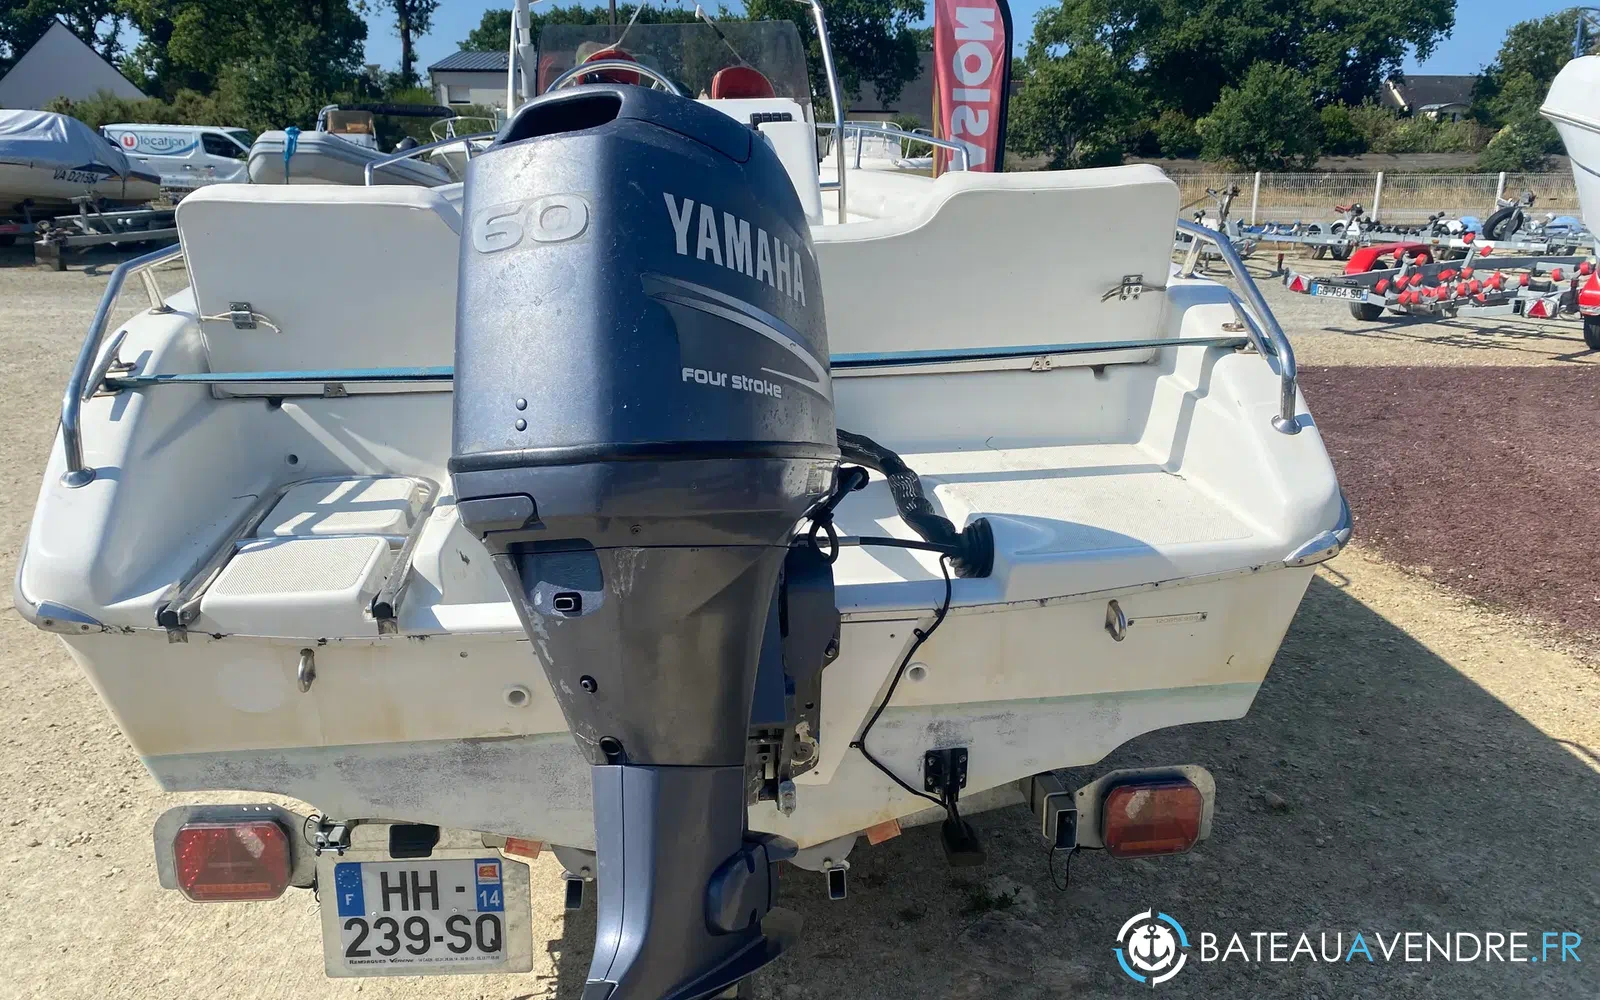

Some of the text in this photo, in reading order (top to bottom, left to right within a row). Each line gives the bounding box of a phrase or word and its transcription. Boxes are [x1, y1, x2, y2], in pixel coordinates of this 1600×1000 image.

[140, 135, 186, 147] location
[472, 192, 590, 254] 60
[662, 191, 806, 307] YAMAHA
[345, 893, 354, 906] F
[479, 890, 500, 907] 14
[343, 913, 502, 958] 239-SQ
